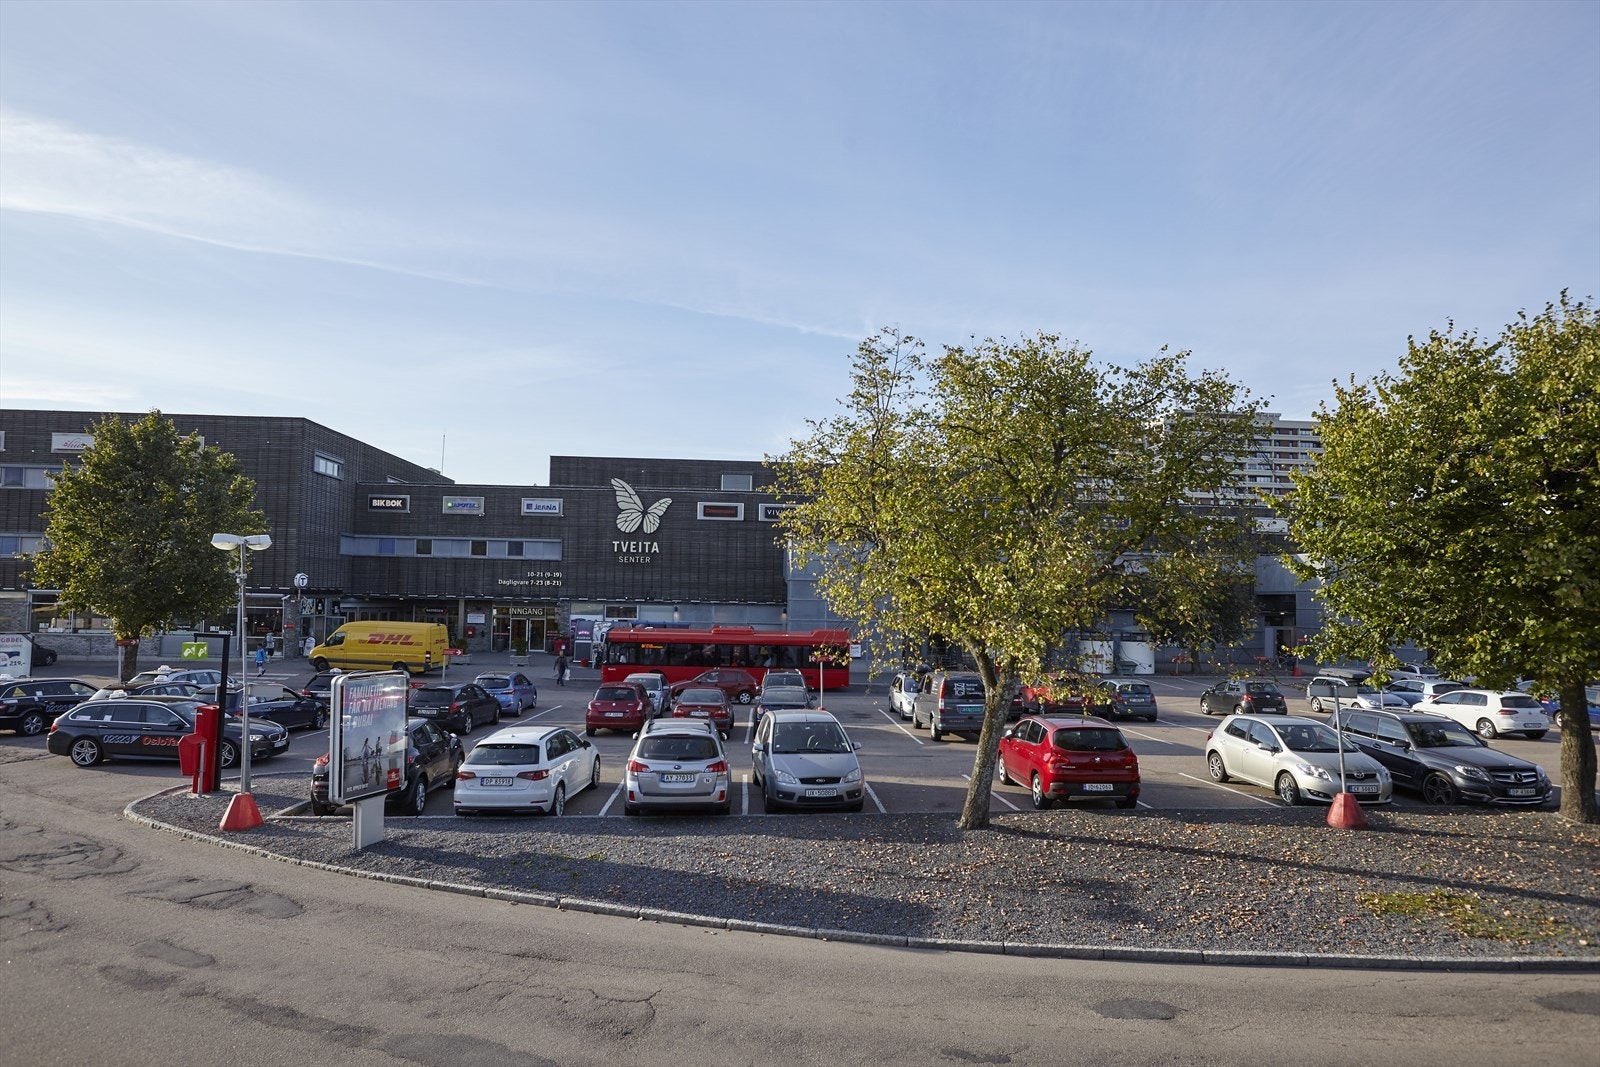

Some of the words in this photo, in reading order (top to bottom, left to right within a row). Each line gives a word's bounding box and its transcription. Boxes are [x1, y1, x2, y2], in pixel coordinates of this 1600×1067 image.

[612, 541, 660, 553] TVEITA
[618, 555, 651, 564] SENTER
[509, 607, 544, 616] INNGANG
[367, 633, 414, 646] DHL
[103, 734, 132, 744] 02323
[142, 735, 179, 747] OsloTa
